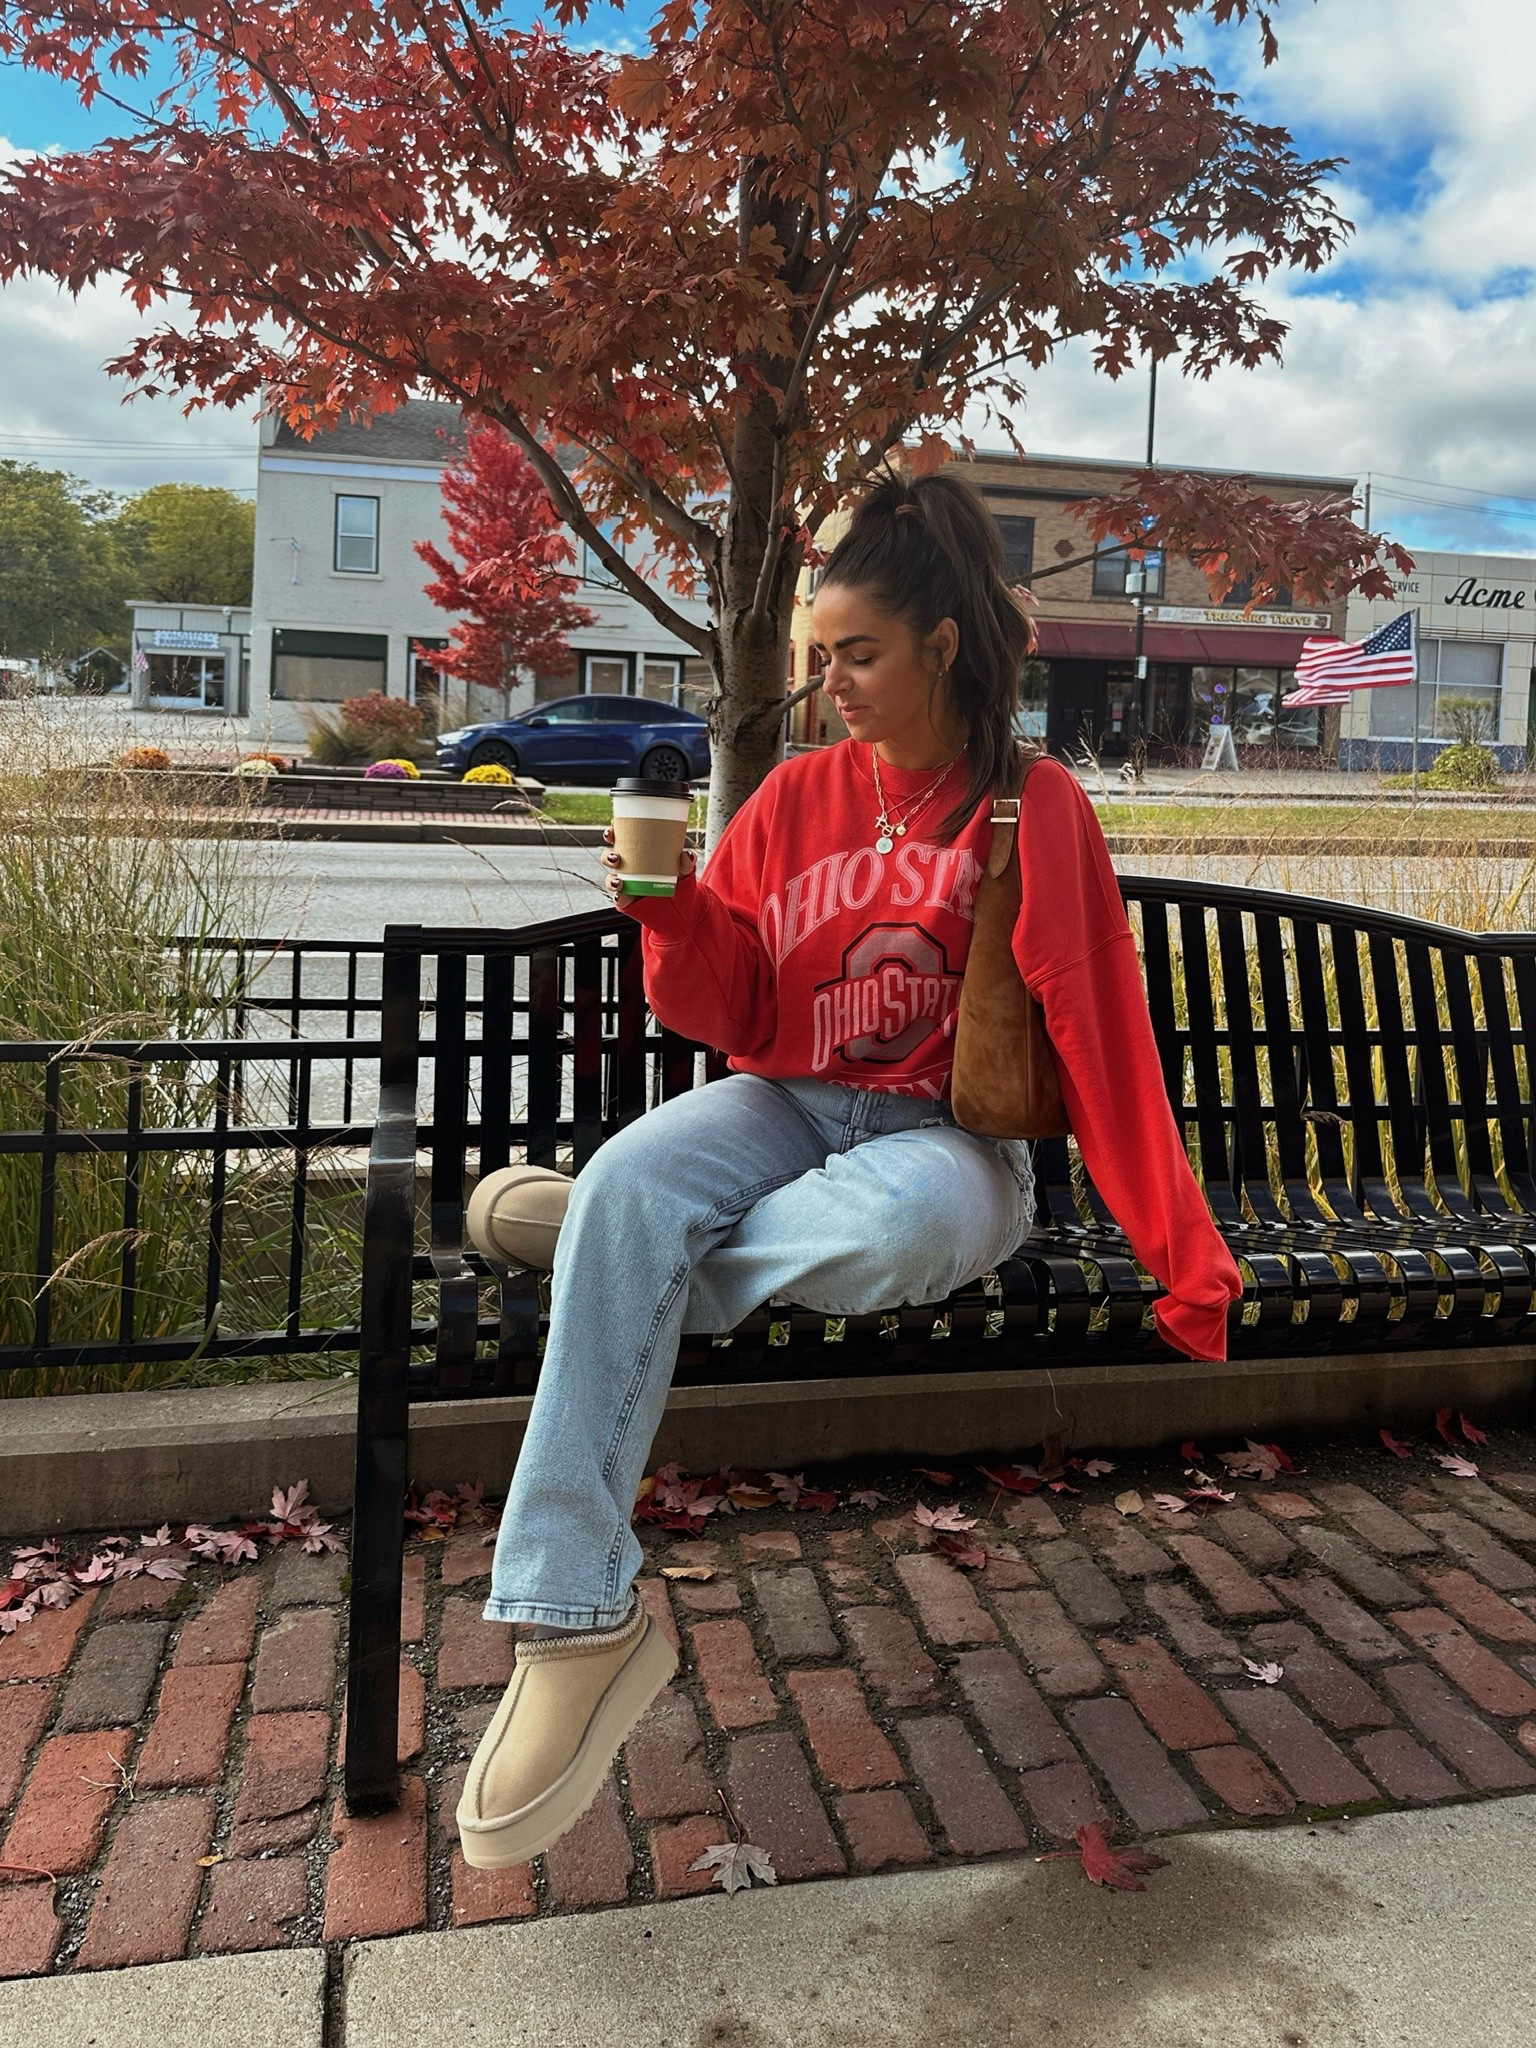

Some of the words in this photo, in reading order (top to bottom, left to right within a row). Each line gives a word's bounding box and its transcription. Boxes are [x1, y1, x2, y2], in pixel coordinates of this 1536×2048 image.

[1444, 577, 1526, 609] Acme
[1270, 612, 1312, 626] TROVE
[760, 846, 885, 970] OHIO
[890, 841, 984, 923] STA
